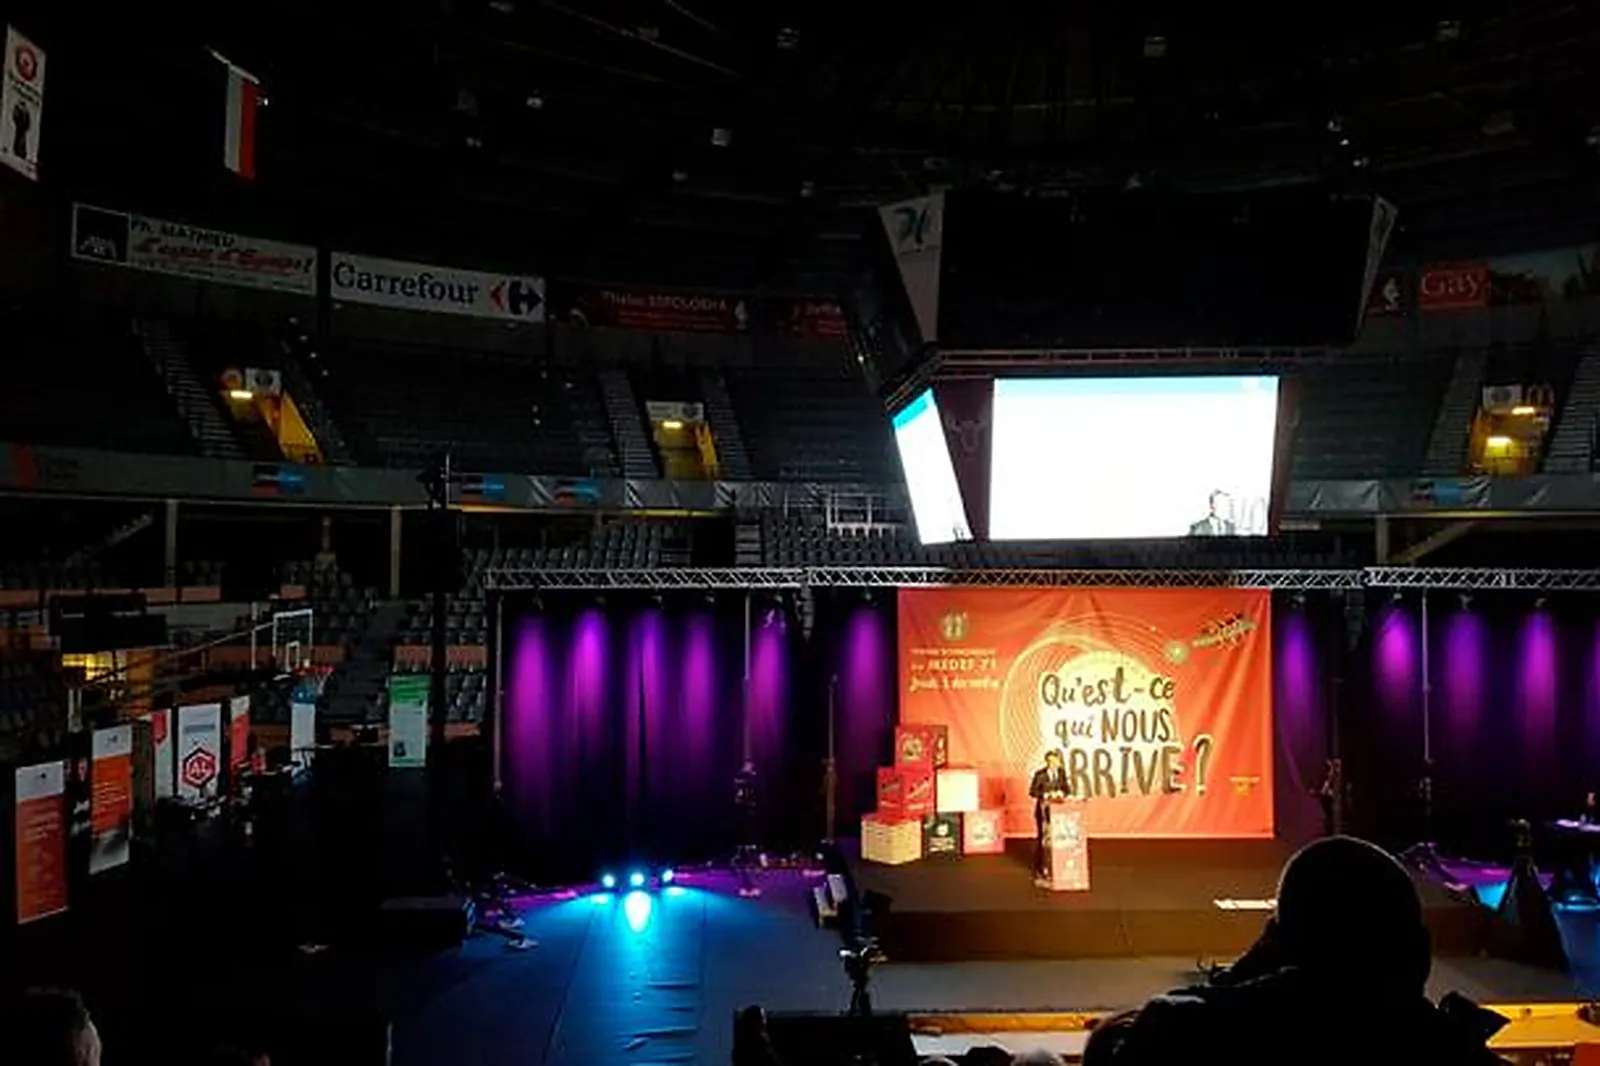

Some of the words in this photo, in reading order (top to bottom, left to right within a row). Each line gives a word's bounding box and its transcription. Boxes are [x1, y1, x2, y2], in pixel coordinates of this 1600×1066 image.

[333, 261, 479, 304] Carrefour
[1041, 666, 1176, 708] Qu'est-ce
[1054, 714, 1094, 748] qui
[1100, 707, 1172, 744] NOUS
